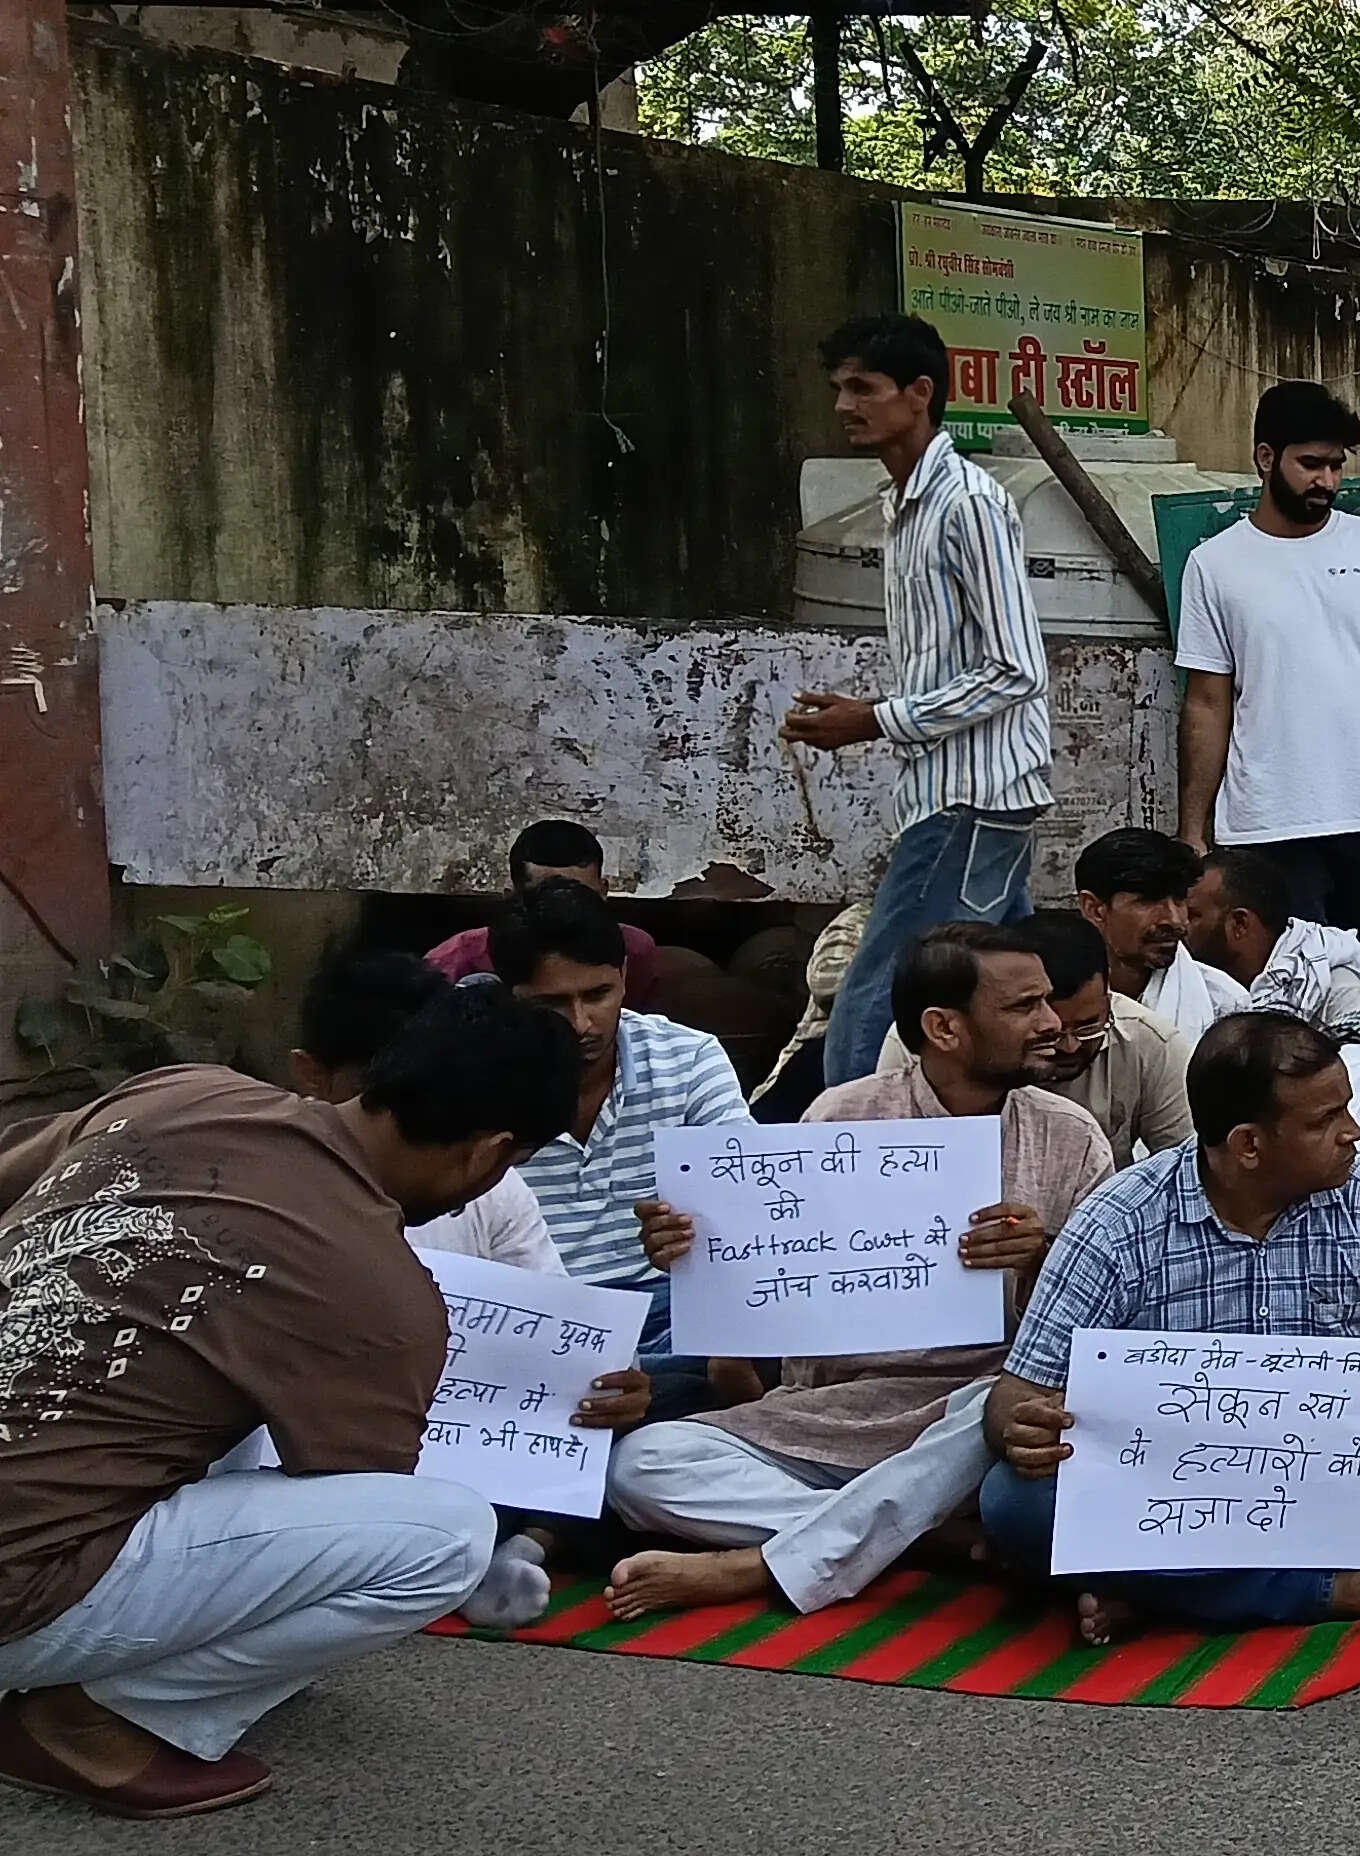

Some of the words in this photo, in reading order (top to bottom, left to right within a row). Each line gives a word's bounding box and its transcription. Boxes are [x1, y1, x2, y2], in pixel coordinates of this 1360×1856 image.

[911, 284, 934, 310] आते
[1029, 296, 1042, 321] ले
[1043, 302, 1062, 323] जय
[1064, 299, 1077, 325] श्री
[1102, 309, 1117, 327] का
[1008, 335, 1048, 407] टी
[1055, 339, 1140, 412] स्टॉल
[708, 1137, 814, 1189] सेकून
[820, 1132, 862, 1174] की
[877, 1145, 945, 1177] हत्या
[763, 1190, 806, 1221] की
[849, 1229, 915, 1253] Court
[924, 1216, 952, 1247] से
[745, 1267, 820, 1308] जांच
[551, 1319, 613, 1356] युवक
[1200, 1338, 1244, 1370] मेव
[434, 1377, 508, 1405] हत्या
[1156, 1371, 1291, 1429] सेकून
[479, 1420, 520, 1452] भी
[1119, 1427, 1153, 1467] के
[1172, 1432, 1322, 1483] हत्यारों
[1138, 1497, 1243, 1535] सजा
[1246, 1485, 1298, 1532] दो
